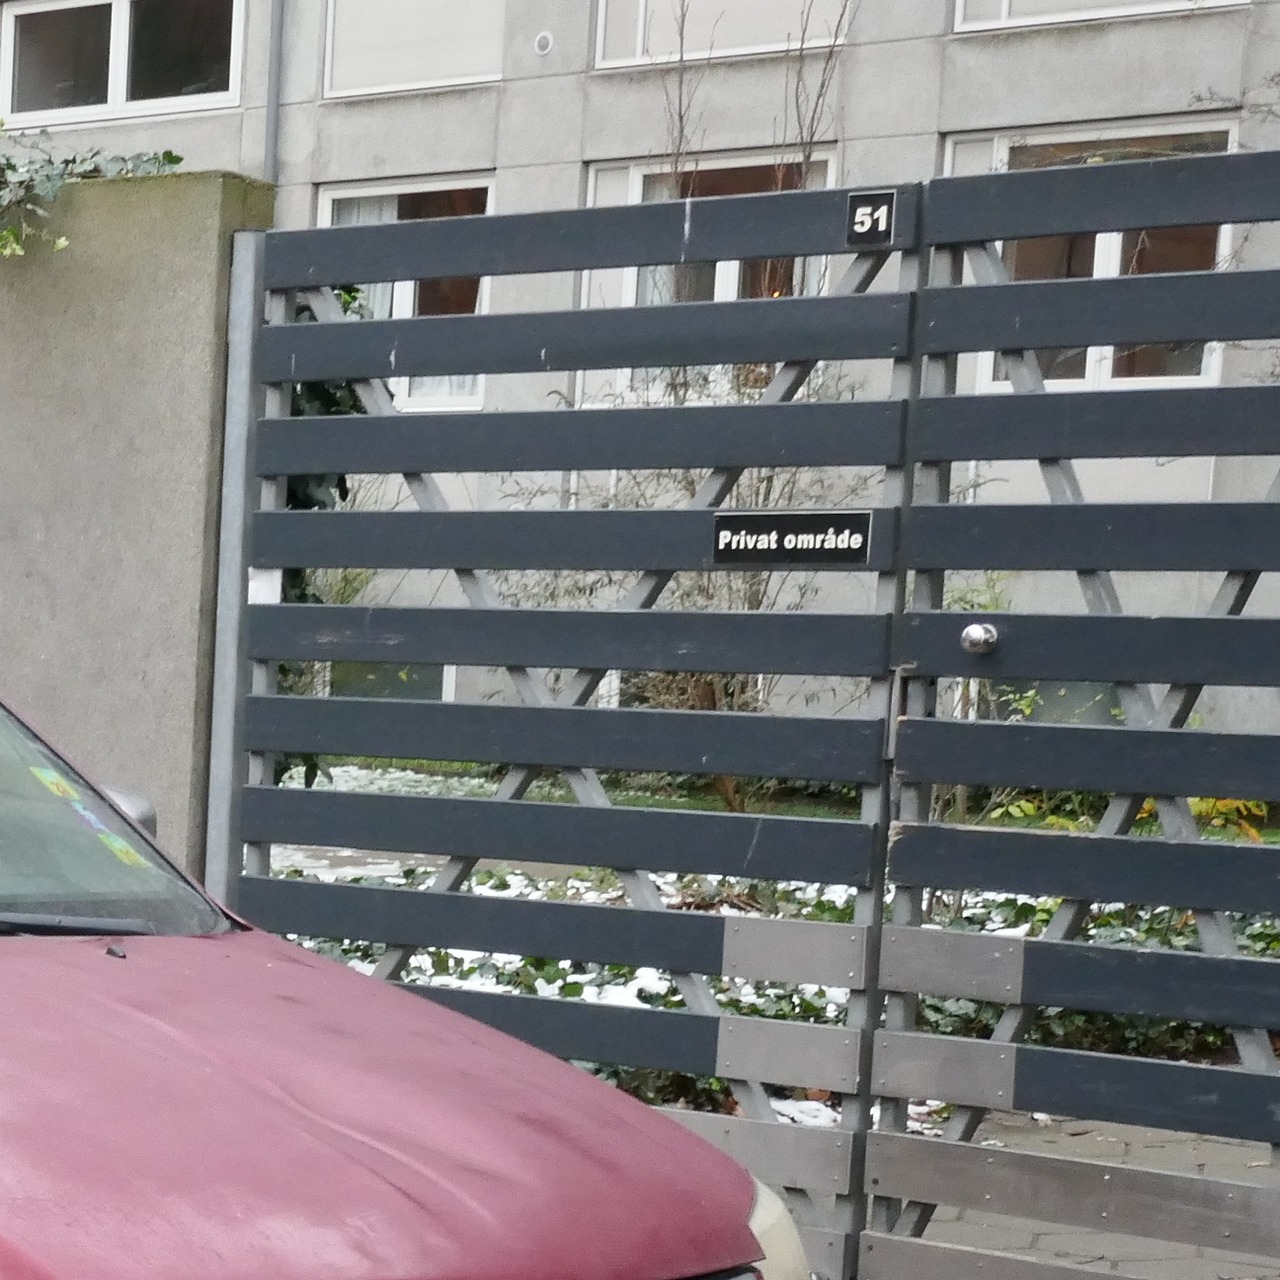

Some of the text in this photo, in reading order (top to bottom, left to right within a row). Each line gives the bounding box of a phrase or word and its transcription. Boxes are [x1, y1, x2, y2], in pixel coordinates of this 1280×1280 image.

[852, 204, 889, 234] 51
[718, 526, 864, 550] Privat område
